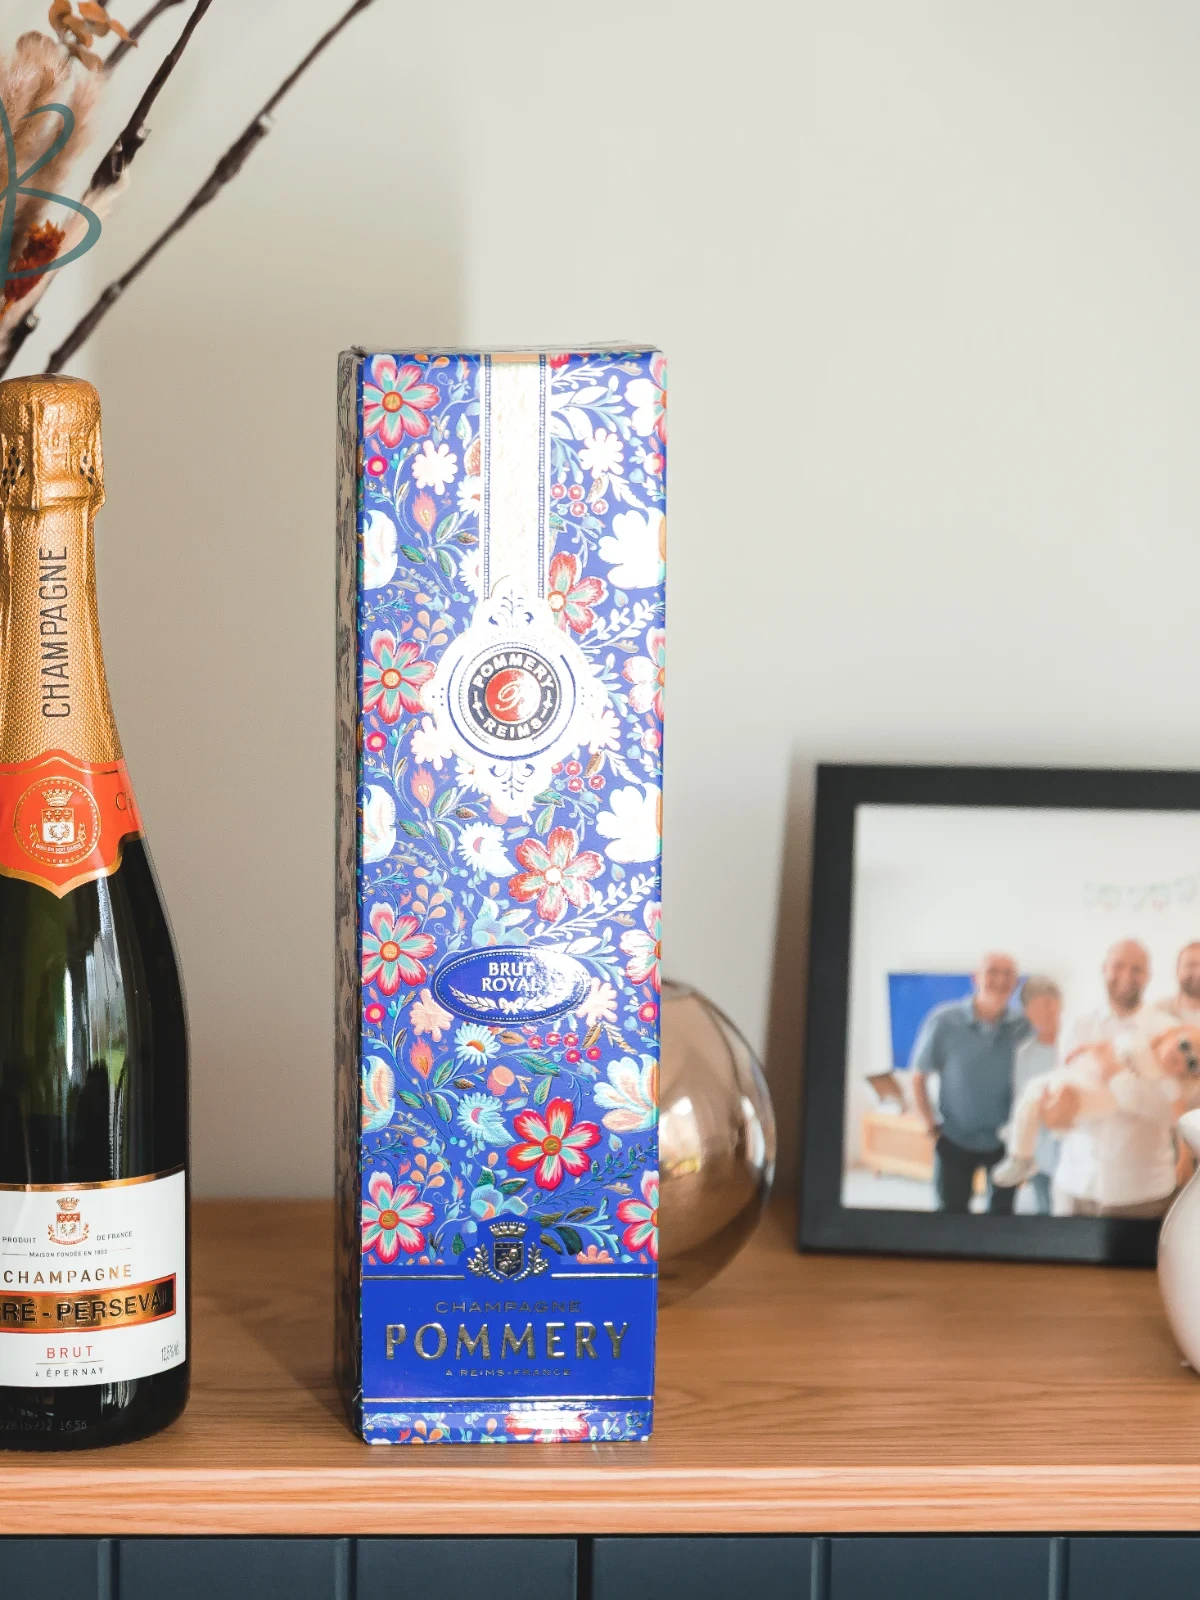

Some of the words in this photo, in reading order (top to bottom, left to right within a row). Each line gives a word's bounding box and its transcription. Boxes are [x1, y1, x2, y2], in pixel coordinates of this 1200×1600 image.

[38, 546, 71, 719] CHAMPAGNE
[472, 653, 554, 688] POMMERY
[483, 717, 542, 738] REIMS
[488, 962, 534, 977] BRUT
[481, 977, 541, 992] ROYAL
[2, 1236, 37, 1244] PRODUIT
[107, 1231, 133, 1239] FRANCE
[3, 1264, 132, 1284] CHAMPAGNE
[435, 1301, 582, 1314] CHAMPAGNE
[385, 1321, 630, 1361] POMMERY
[46, 1345, 94, 1360] BRUT
[46, 1367, 104, 1378] ÉPERNAY
